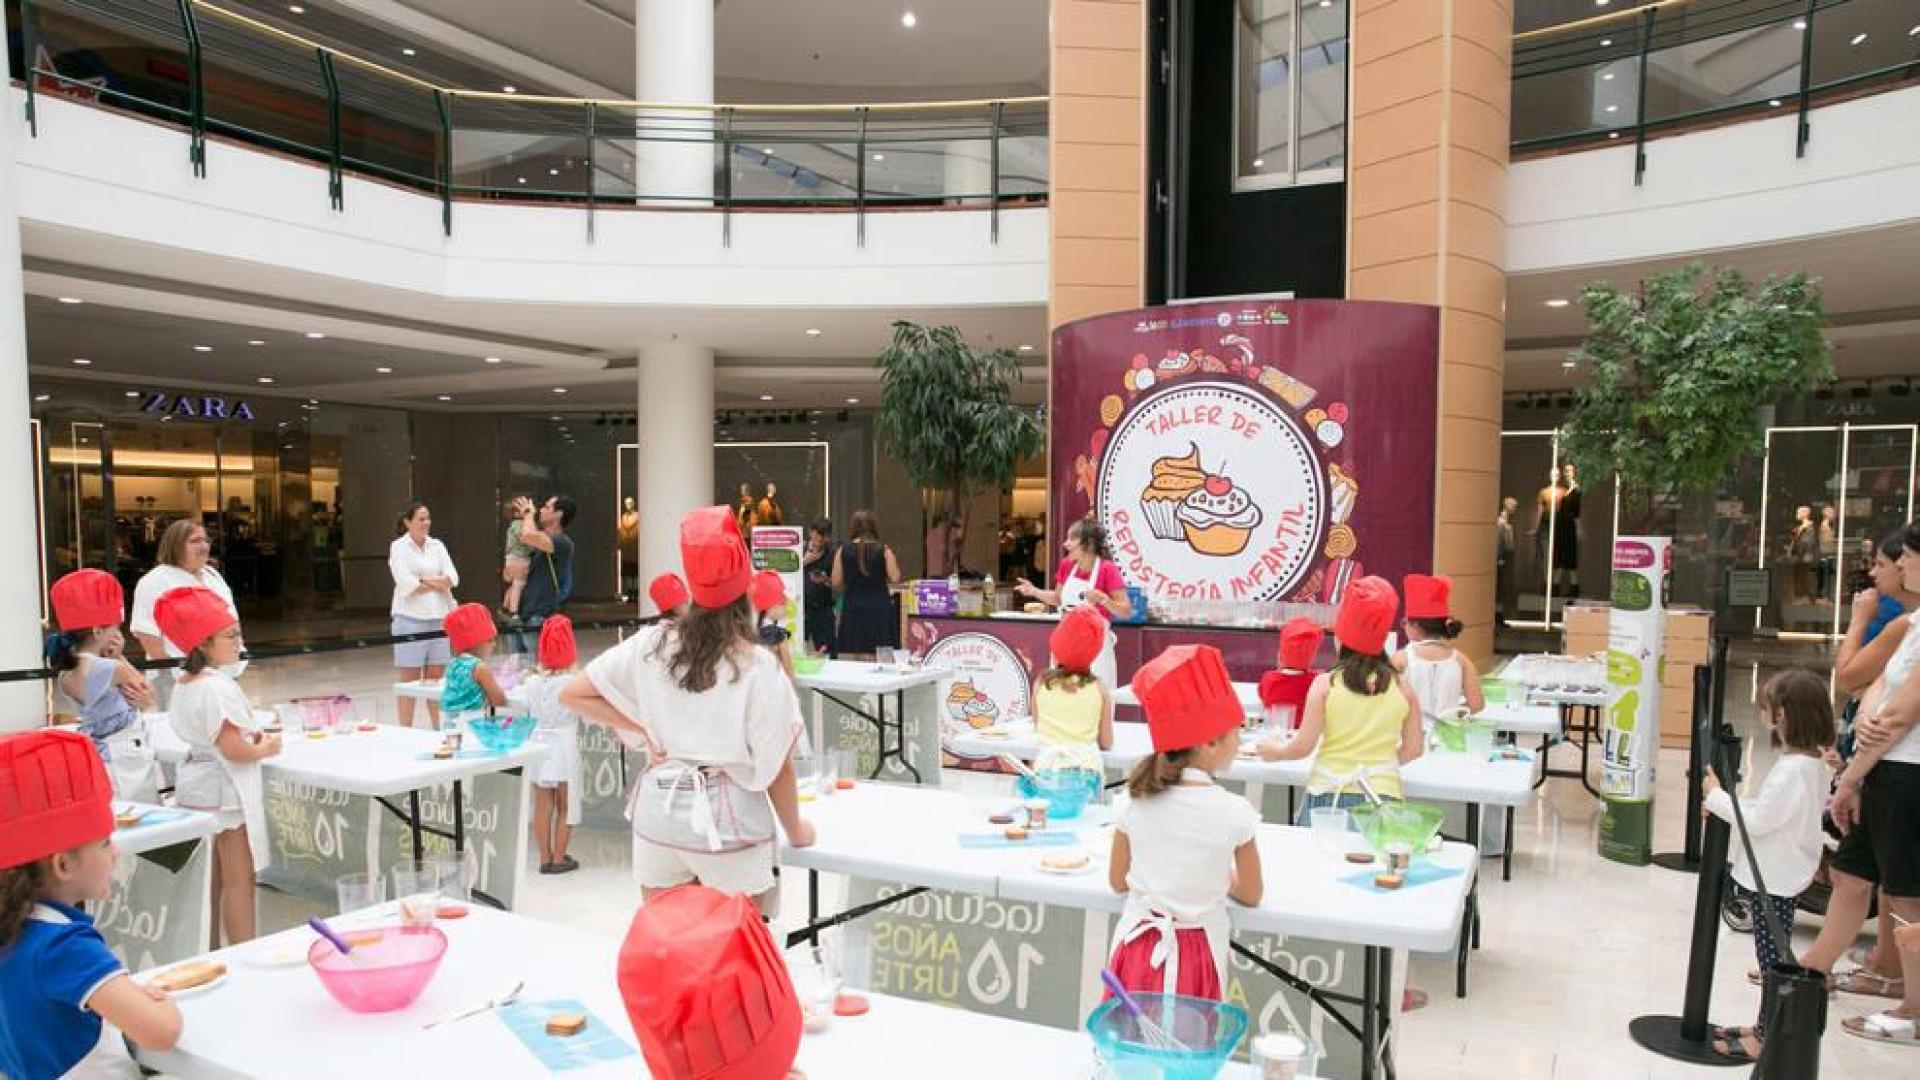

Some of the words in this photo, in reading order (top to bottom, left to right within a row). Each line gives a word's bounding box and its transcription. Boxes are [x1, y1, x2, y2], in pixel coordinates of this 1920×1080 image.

[140, 393, 256, 421] ZARA
[1146, 405, 1221, 437] TALLER
[1232, 413, 1261, 440] DE
[1113, 509, 1223, 600] REPOSTERÍA
[1229, 503, 1305, 599] INFANTIL
